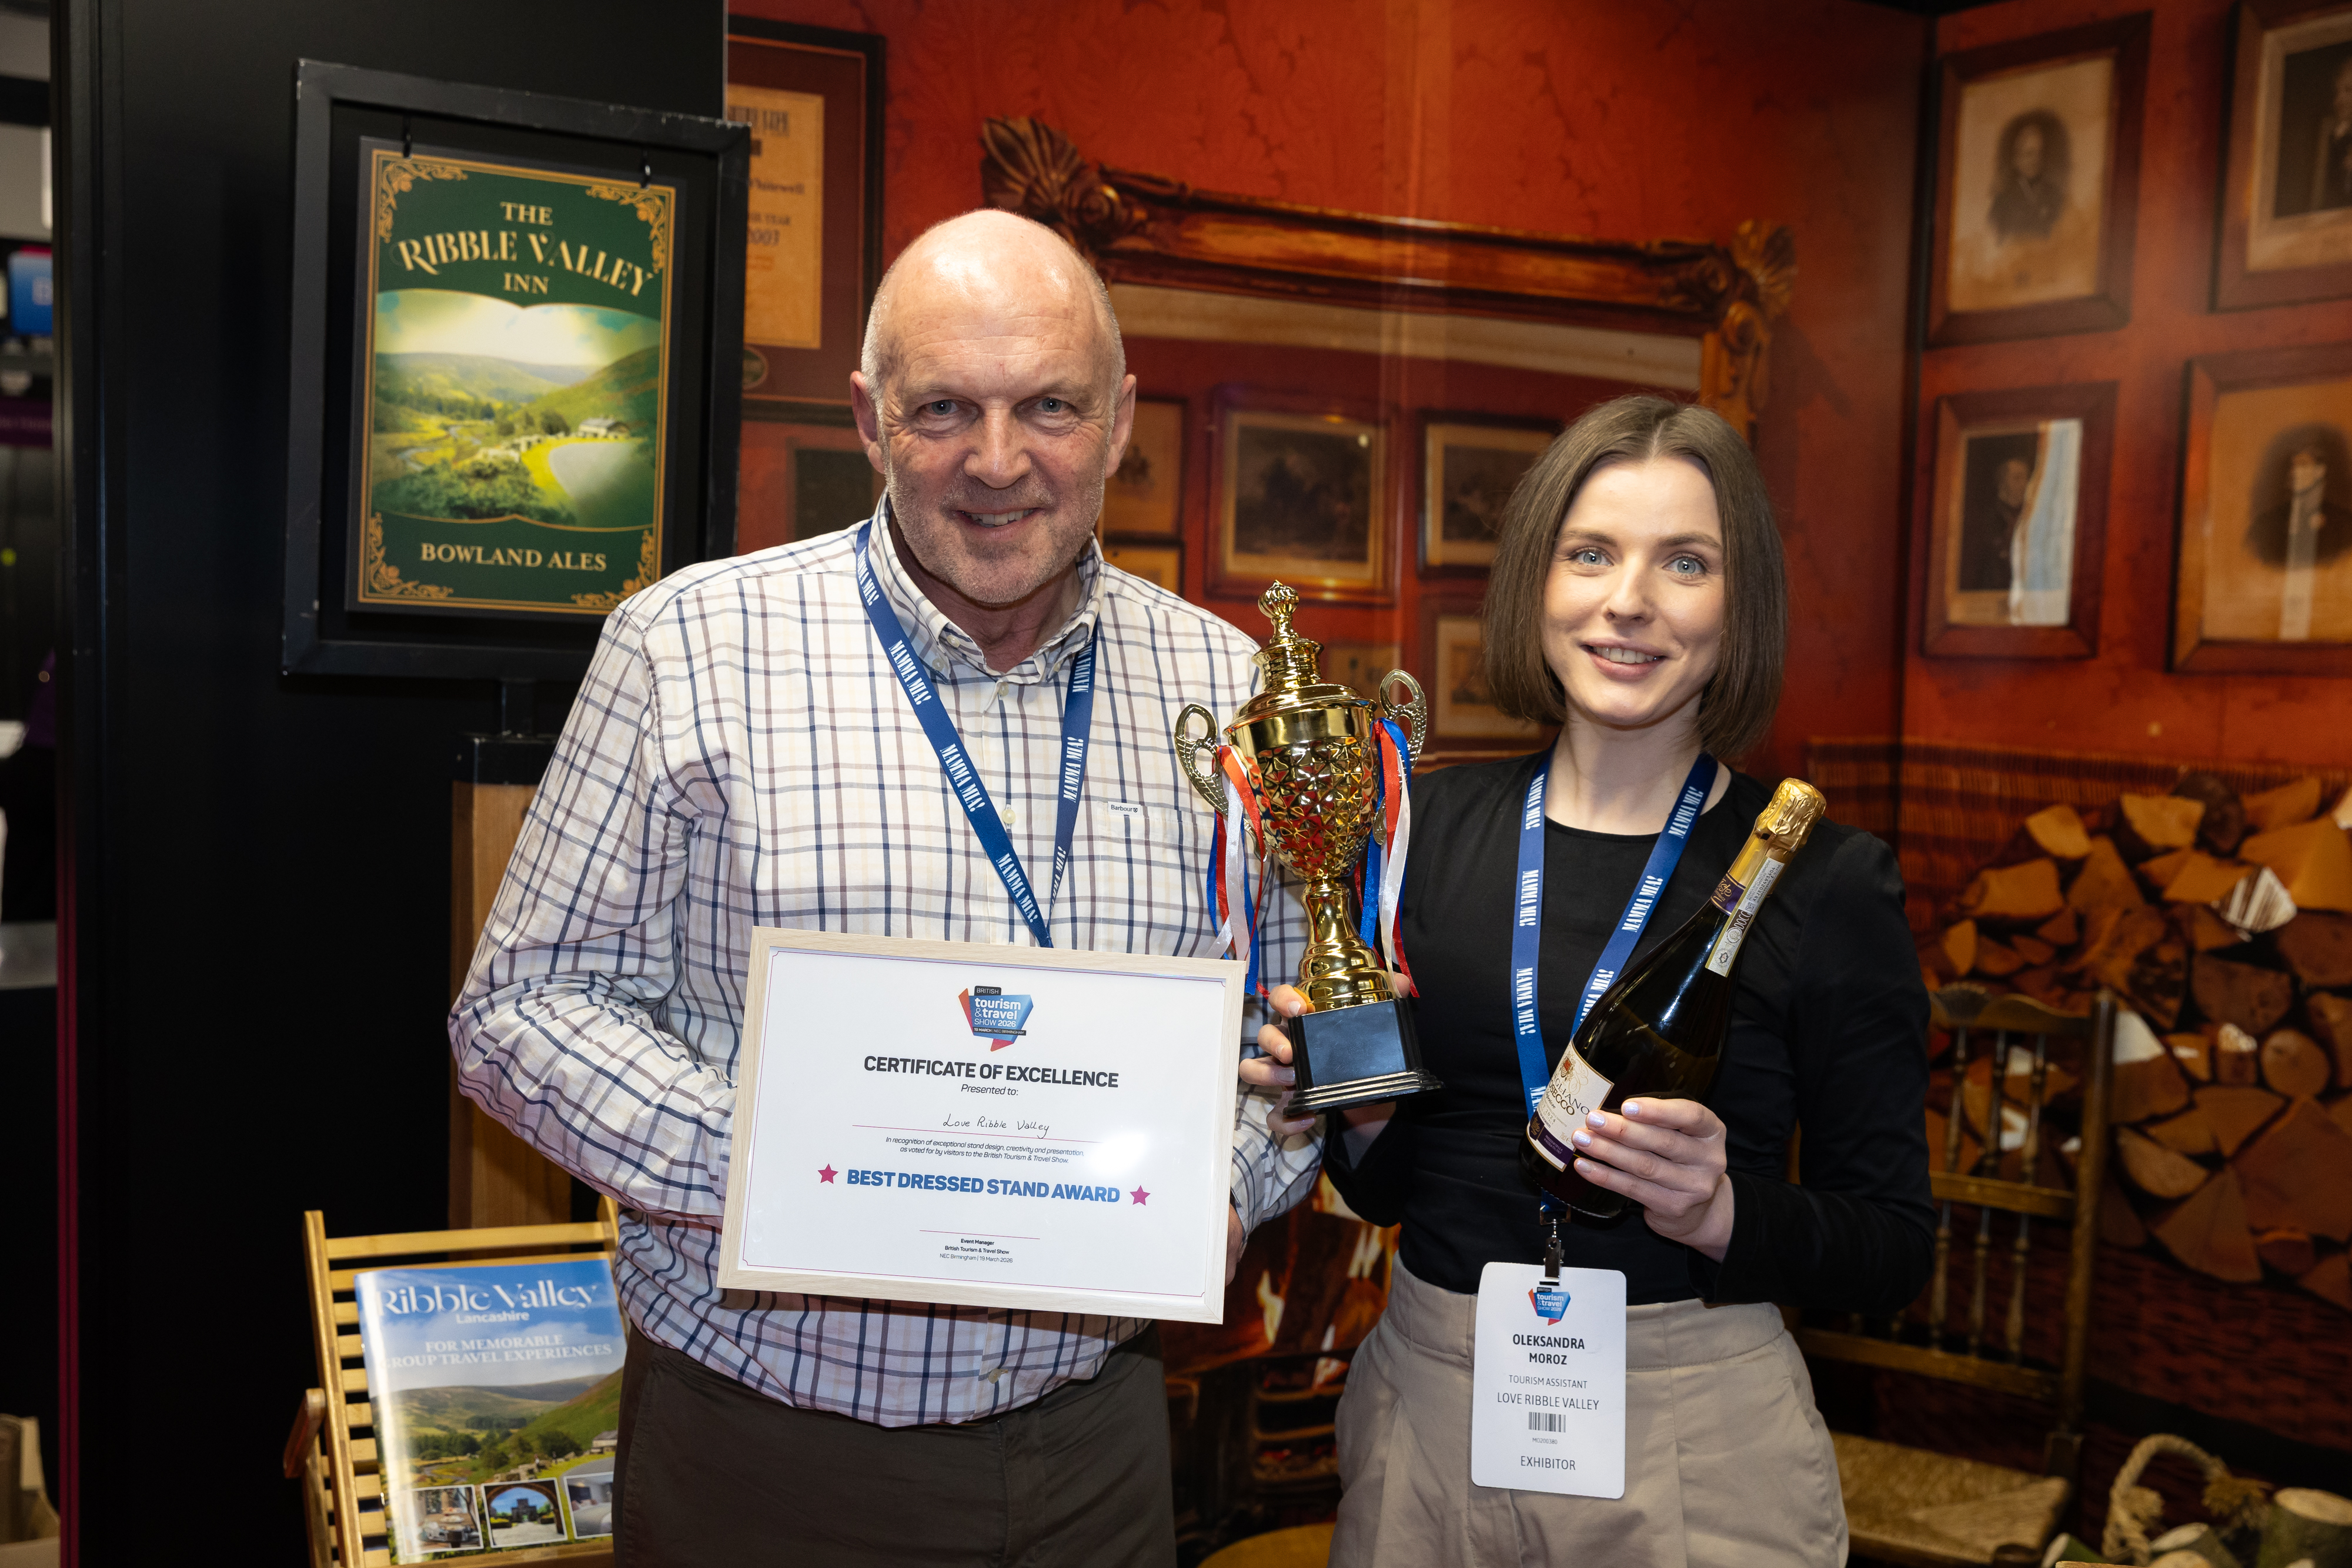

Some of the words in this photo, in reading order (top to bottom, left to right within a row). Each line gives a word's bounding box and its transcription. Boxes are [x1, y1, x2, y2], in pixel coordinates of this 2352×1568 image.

[500, 201, 553, 226] THE
[391, 230, 518, 275] RIBBLE
[528, 229, 654, 297] VALLEY
[503, 272, 549, 295] INN
[420, 541, 543, 567] BOWLAND
[547, 551, 607, 572] ALES
[862, 578, 880, 606] MIA!
[888, 640, 918, 683] MAMMA
[907, 677, 932, 705] MIA!
[1073, 657, 1091, 693] MAMMA
[1067, 737, 1084, 762] MIA!
[940, 743, 972, 787] MAMMA
[960, 784, 985, 812] MIA!
[1063, 762, 1081, 803] MAMMA
[1527, 773, 1545, 809] MAMMA
[1525, 806, 1541, 830] MIA!
[1668, 805, 1696, 839] MAMMA
[1683, 786, 1704, 808] MIA!
[1056, 846, 1066, 875] MIA!
[995, 853, 1025, 898] MAMMA
[1018, 894, 1038, 923] MIA!
[1521, 870, 1539, 905] MAMMA
[1519, 905, 1536, 927] MIA!
[1621, 898, 1653, 932] MAMMA
[1639, 875, 1663, 898] MIA!
[1734, 911, 1751, 929] DOCG
[1516, 967, 1533, 1008] MAMMA
[1591, 969, 1614, 992] MIA!
[975, 998, 1021, 1009] tourism
[1518, 1008, 1536, 1035] MIA!
[864, 1055, 976, 1078] CERTIFICATE
[979, 1064, 1003, 1079] OF
[1005, 1065, 1119, 1088] EXCELLENCE
[961, 1084, 1006, 1095] Presented
[1007, 1086, 1019, 1096] to:
[943, 1114, 970, 1128] Love
[977, 1115, 1007, 1129] Ribble
[1017, 1120, 1050, 1139] Valley
[1546, 1109, 1555, 1122] 2024
[893, 1137, 924, 1145] recognition
[1006, 1145, 1033, 1154] creativity
[1046, 1148, 1084, 1156] presentation,
[847, 1169, 896, 1187] BEST
[897, 1172, 984, 1193] DRESSED
[987, 1179, 1050, 1198] STAND
[1051, 1183, 1120, 1203] AWARD
[378, 1284, 493, 1316] Ribble
[492, 1279, 597, 1310] Valley
[456, 1310, 529, 1325] Lancashire
[425, 1340, 457, 1353] FOR
[460, 1334, 564, 1353] MEMORABLE
[1513, 1333, 1585, 1349] OLEKSANDRA
[381, 1355, 437, 1369] GROUP
[440, 1351, 502, 1366] TRAVEL
[505, 1343, 612, 1362] EXPERIENCES
[1529, 1353, 1567, 1365] MOROZ
[1509, 1375, 1544, 1385] TOURISM
[1546, 1378, 1587, 1389] ASSISTANT
[1498, 1392, 1522, 1404] LOVE
[1525, 1394, 1560, 1407] RIBBLE
[1562, 1398, 1599, 1410] VALLEY
[1521, 1456, 1575, 1470] EXHIBITOR
